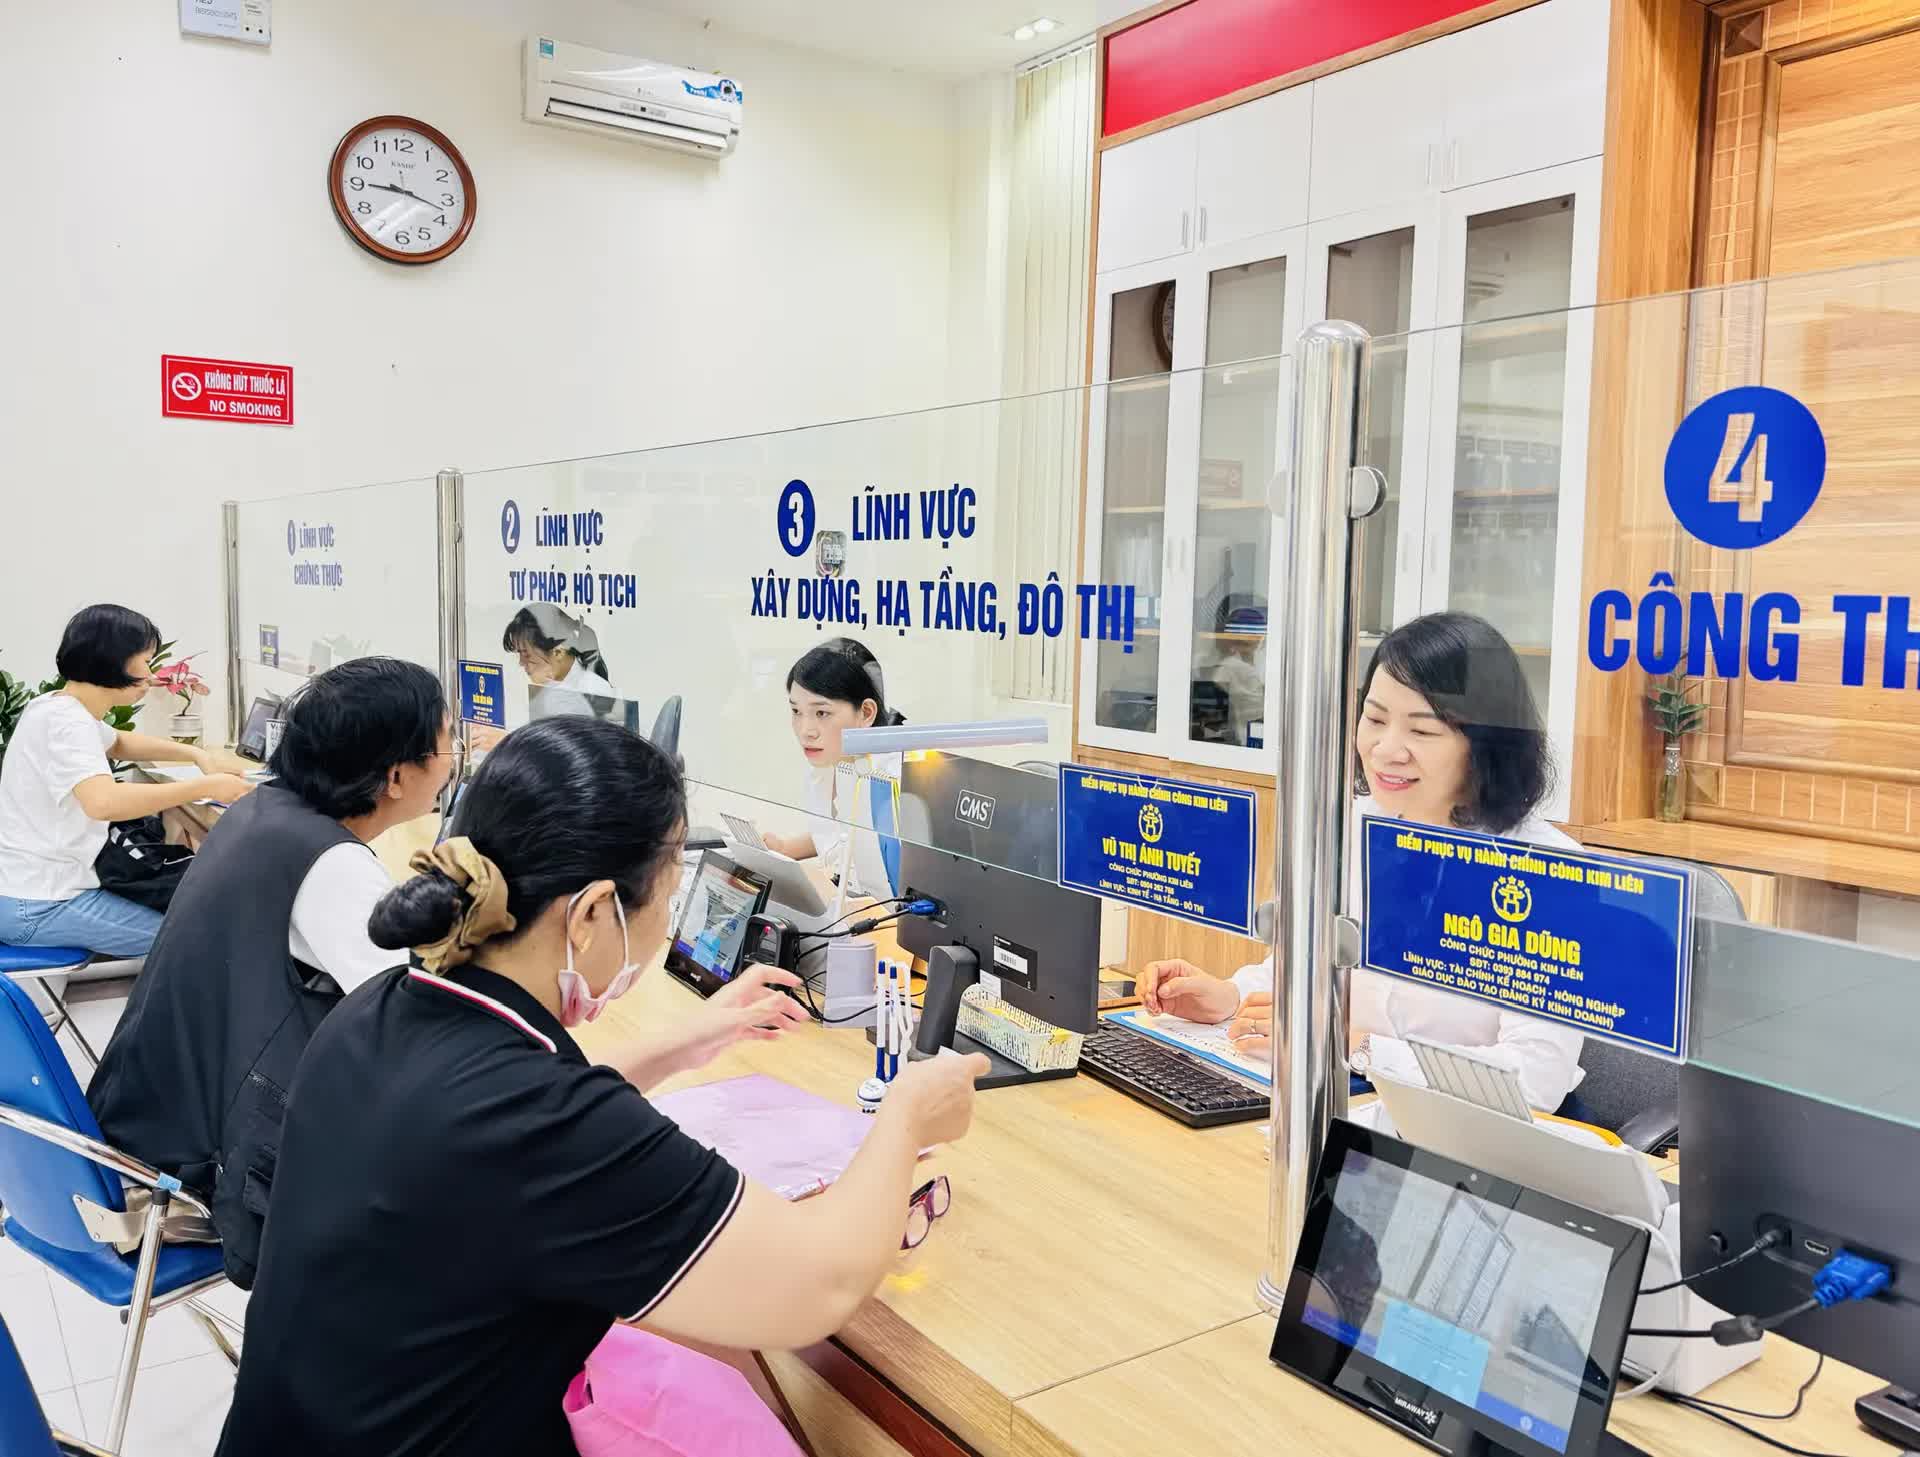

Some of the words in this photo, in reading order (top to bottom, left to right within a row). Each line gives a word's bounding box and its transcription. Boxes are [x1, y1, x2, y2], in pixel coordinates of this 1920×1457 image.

[373, 139, 387, 154] 11
[393, 137, 415, 154] 12
[424, 149, 430, 163] 1
[356, 156, 374, 170] 10
[350, 176, 365, 191] 9
[435, 169, 449, 183] 2
[357, 201, 372, 215] 8
[441, 193, 455, 207] 3
[432, 214, 448, 227] 4
[395, 231, 411, 245] 6
[418, 227, 431, 241] 5
[204, 369, 232, 391] KHÔNG
[233, 371, 249, 392] HÚT
[209, 399, 227, 412] NO
[229, 401, 282, 417] SMOKING
[1707, 412, 1773, 523] 4
[787, 491, 805, 548] 3
[852, 485, 910, 542] LĨNH
[920, 483, 976, 549] VỰC
[506, 506, 516, 548] 2
[535, 507, 568, 547] LĨNH
[573, 508, 604, 554] VỰC
[509, 568, 527, 601] TƯ
[529, 564, 569, 608] PHÁP,
[573, 564, 594, 613] HỘ
[598, 573, 637, 616] TỊCH
[750, 568, 791, 618] XÂY
[797, 574, 867, 630] DỰNG,
[876, 579, 911, 637] HẠ
[919, 565, 1006, 641] TẦNG,
[1017, 571, 1064, 638] ĐÔ
[1076, 584, 1135, 654] THỊ
[1587, 571, 1801, 682] CÔNG
[959, 796, 989, 822] CMS
[1119, 841, 1137, 865] THỊ
[1139, 843, 1163, 867] ÁNH
[1166, 851, 1201, 876] TUYẾT
[1396, 831, 1422, 851] ĐIỂM
[1424, 839, 1454, 859] PHỤC
[1456, 845, 1472, 864] VỤ
[1474, 847, 1507, 868] HÀNH
[1509, 854, 1546, 875] CHÍNH
[1549, 861, 1583, 882] CÔNG
[1586, 868, 1611, 888] KIM
[1614, 873, 1644, 895] LIÊN
[1444, 912, 1483, 941] NGÔ
[1487, 922, 1520, 951] GIA
[1525, 930, 1581, 966] DŨNG
[1439, 937, 1466, 952] CÔNG
[1468, 944, 1495, 959] CHỨC
[1497, 951, 1538, 970] PHƯỜNG
[1540, 962, 1558, 975] KIM
[1560, 967, 1584, 981] LIÊN
[1403, 951, 1423, 965] LĨNH
[1449, 963, 1464, 975] TÀI
[1465, 967, 1494, 983] CHÍNH
[1512, 979, 1546, 996] HOẠCH
[1554, 990, 1583, 1007] NÔNG
[1586, 997, 1625, 1018] NGHIỆP
[1533, 973, 1550, 985] 974
[1412, 965, 1434, 979] GIÁO
[1435, 972, 1455, 985] DỤC
[1478, 982, 1497, 995] TẠO
[1547, 1000, 1572, 1017] KINH
[1573, 1008, 1614, 1030] DOANH)
